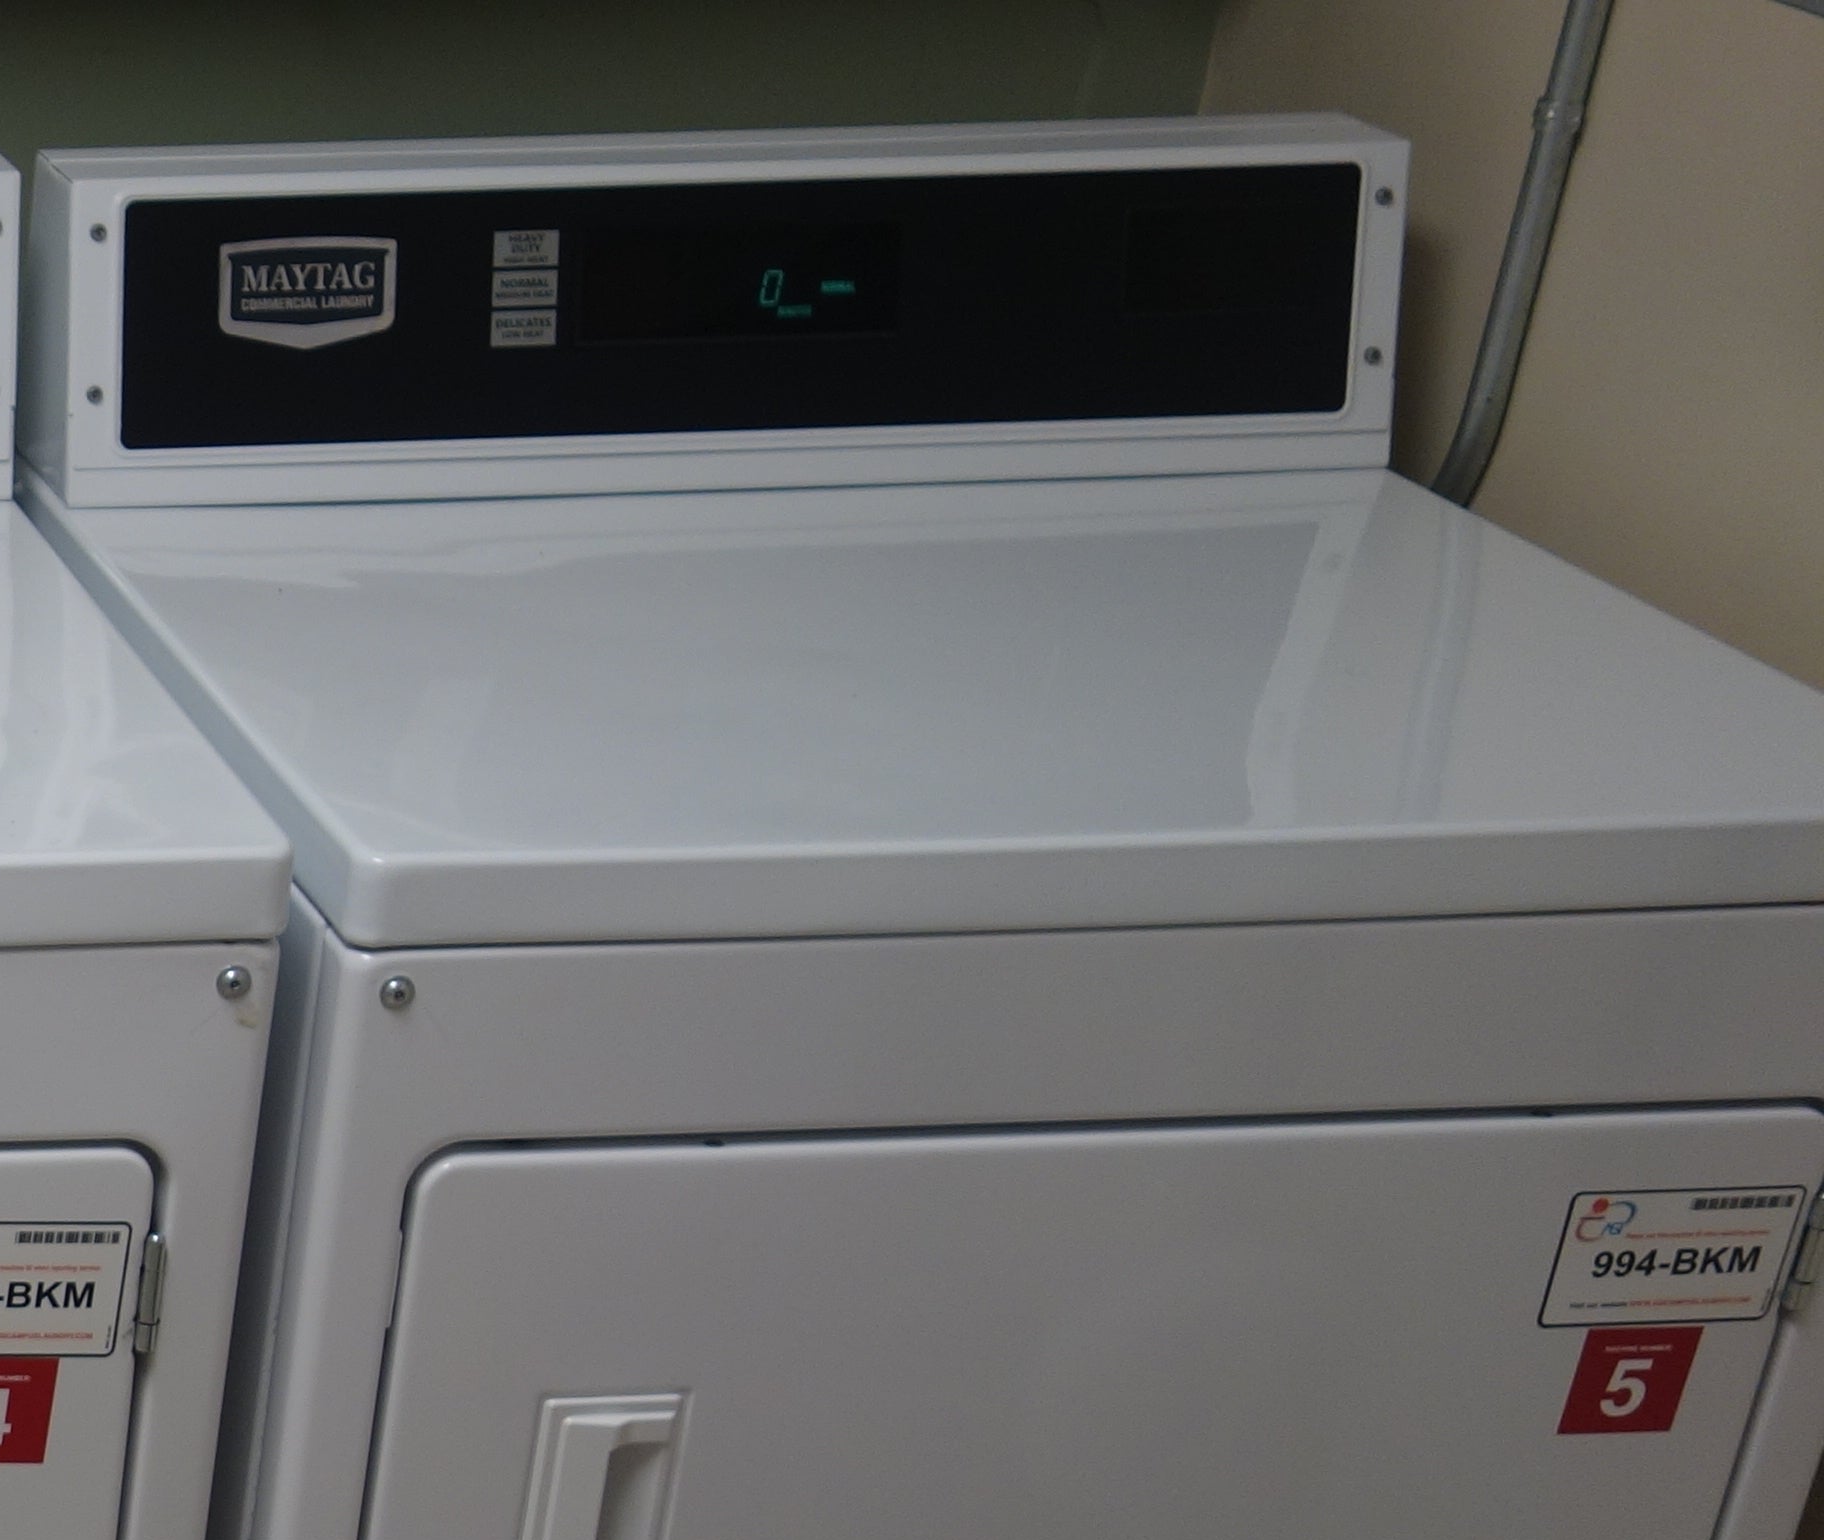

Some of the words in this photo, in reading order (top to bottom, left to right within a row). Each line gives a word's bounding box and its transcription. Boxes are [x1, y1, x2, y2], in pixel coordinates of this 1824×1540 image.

[241, 261, 375, 292] MAYTAG
[241, 297, 318, 311] COMMERCIAL
[321, 294, 374, 308] LAUNDRY
[1592, 1246, 1763, 1278] 994-BKM
[1600, 1358, 1654, 1417] 5
